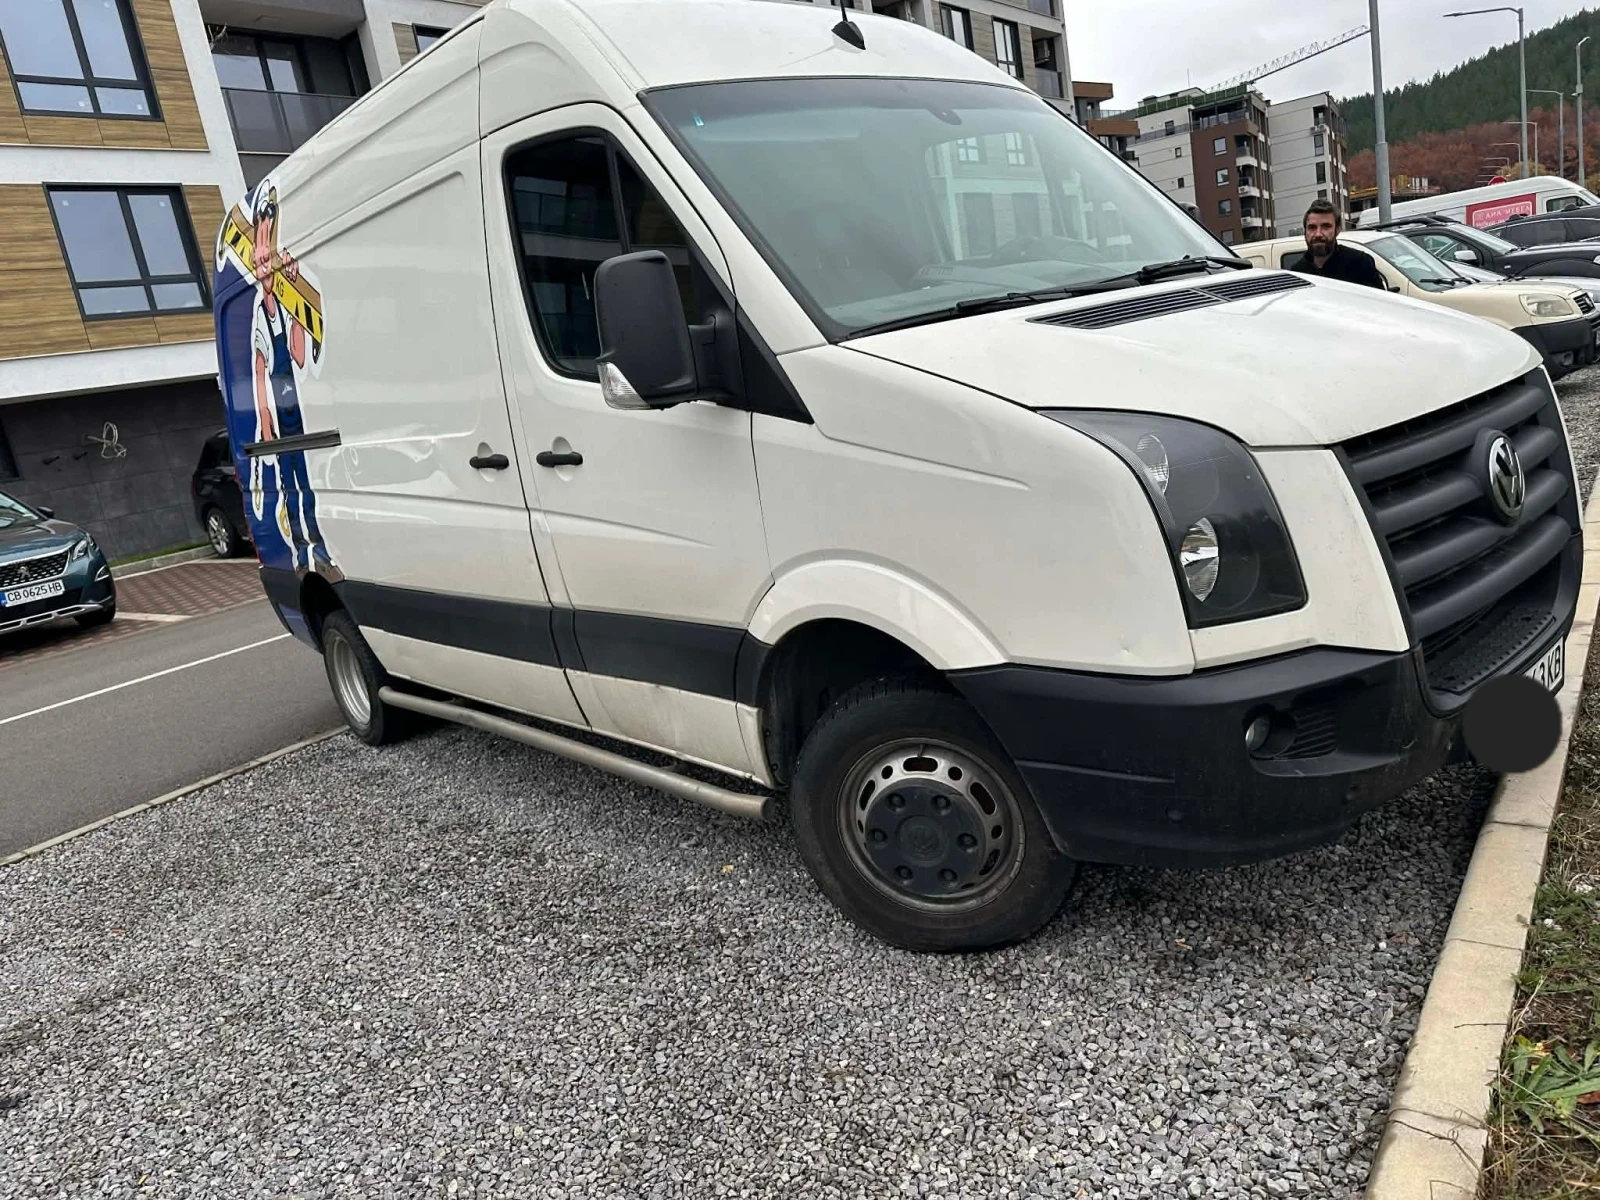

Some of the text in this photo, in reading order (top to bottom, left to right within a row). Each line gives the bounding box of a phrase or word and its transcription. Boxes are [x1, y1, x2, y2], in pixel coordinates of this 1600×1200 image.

[7, 581, 63, 602] CB 0625 HB
